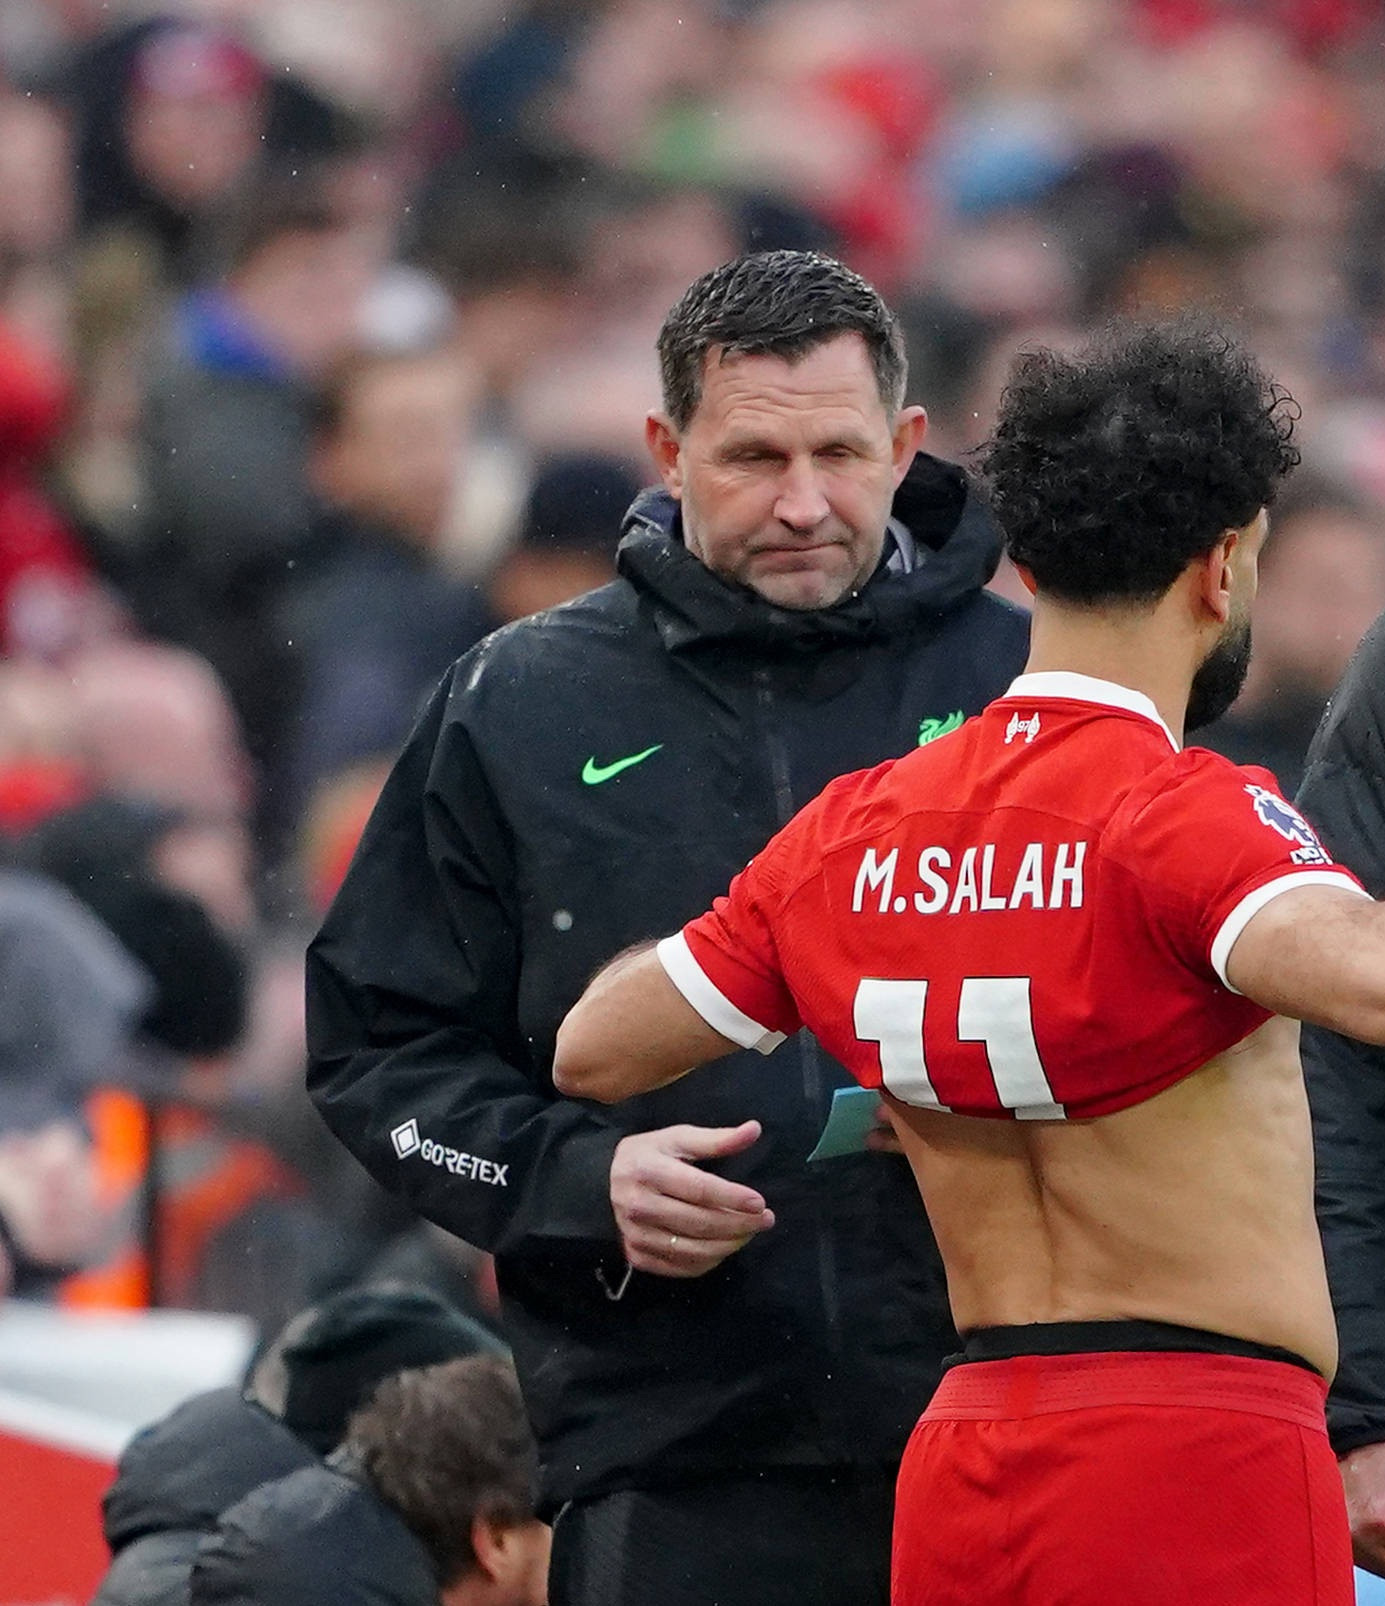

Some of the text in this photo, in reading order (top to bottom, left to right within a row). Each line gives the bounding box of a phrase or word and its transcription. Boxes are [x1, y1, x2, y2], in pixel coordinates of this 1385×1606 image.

[852, 841, 1086, 914] M.SALAH
[853, 976, 1068, 1120] 11
[421, 1138, 509, 1186] GORE-TEX
